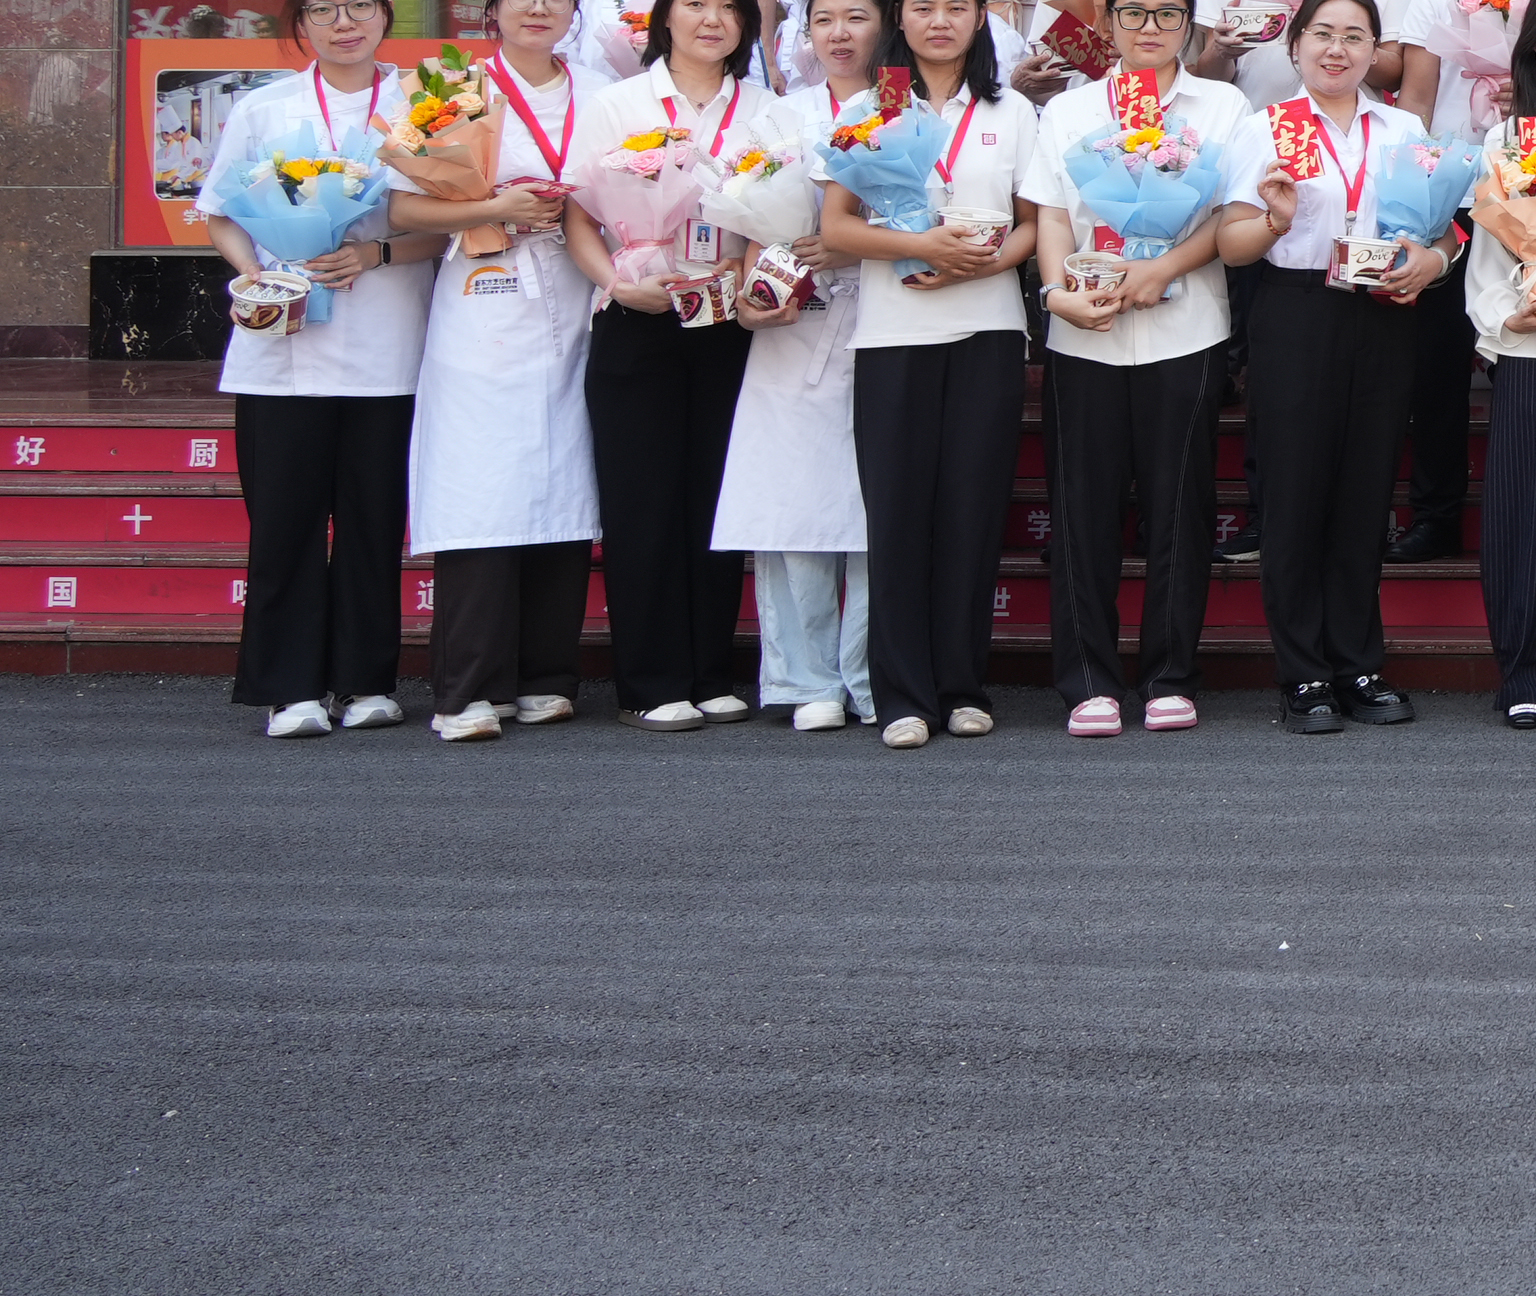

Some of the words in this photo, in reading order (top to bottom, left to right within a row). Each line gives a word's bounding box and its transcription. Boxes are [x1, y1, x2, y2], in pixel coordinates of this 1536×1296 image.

[1228, 10, 1263, 33] Dove
[1269, 101, 1297, 157] 大吉
[1293, 120, 1326, 178] 大利
[1353, 250, 1391, 265] Dove
[15, 436, 45, 470] 好
[189, 438, 218, 469] 厨
[122, 503, 153, 535] 十
[47, 576, 77, 608] 国
